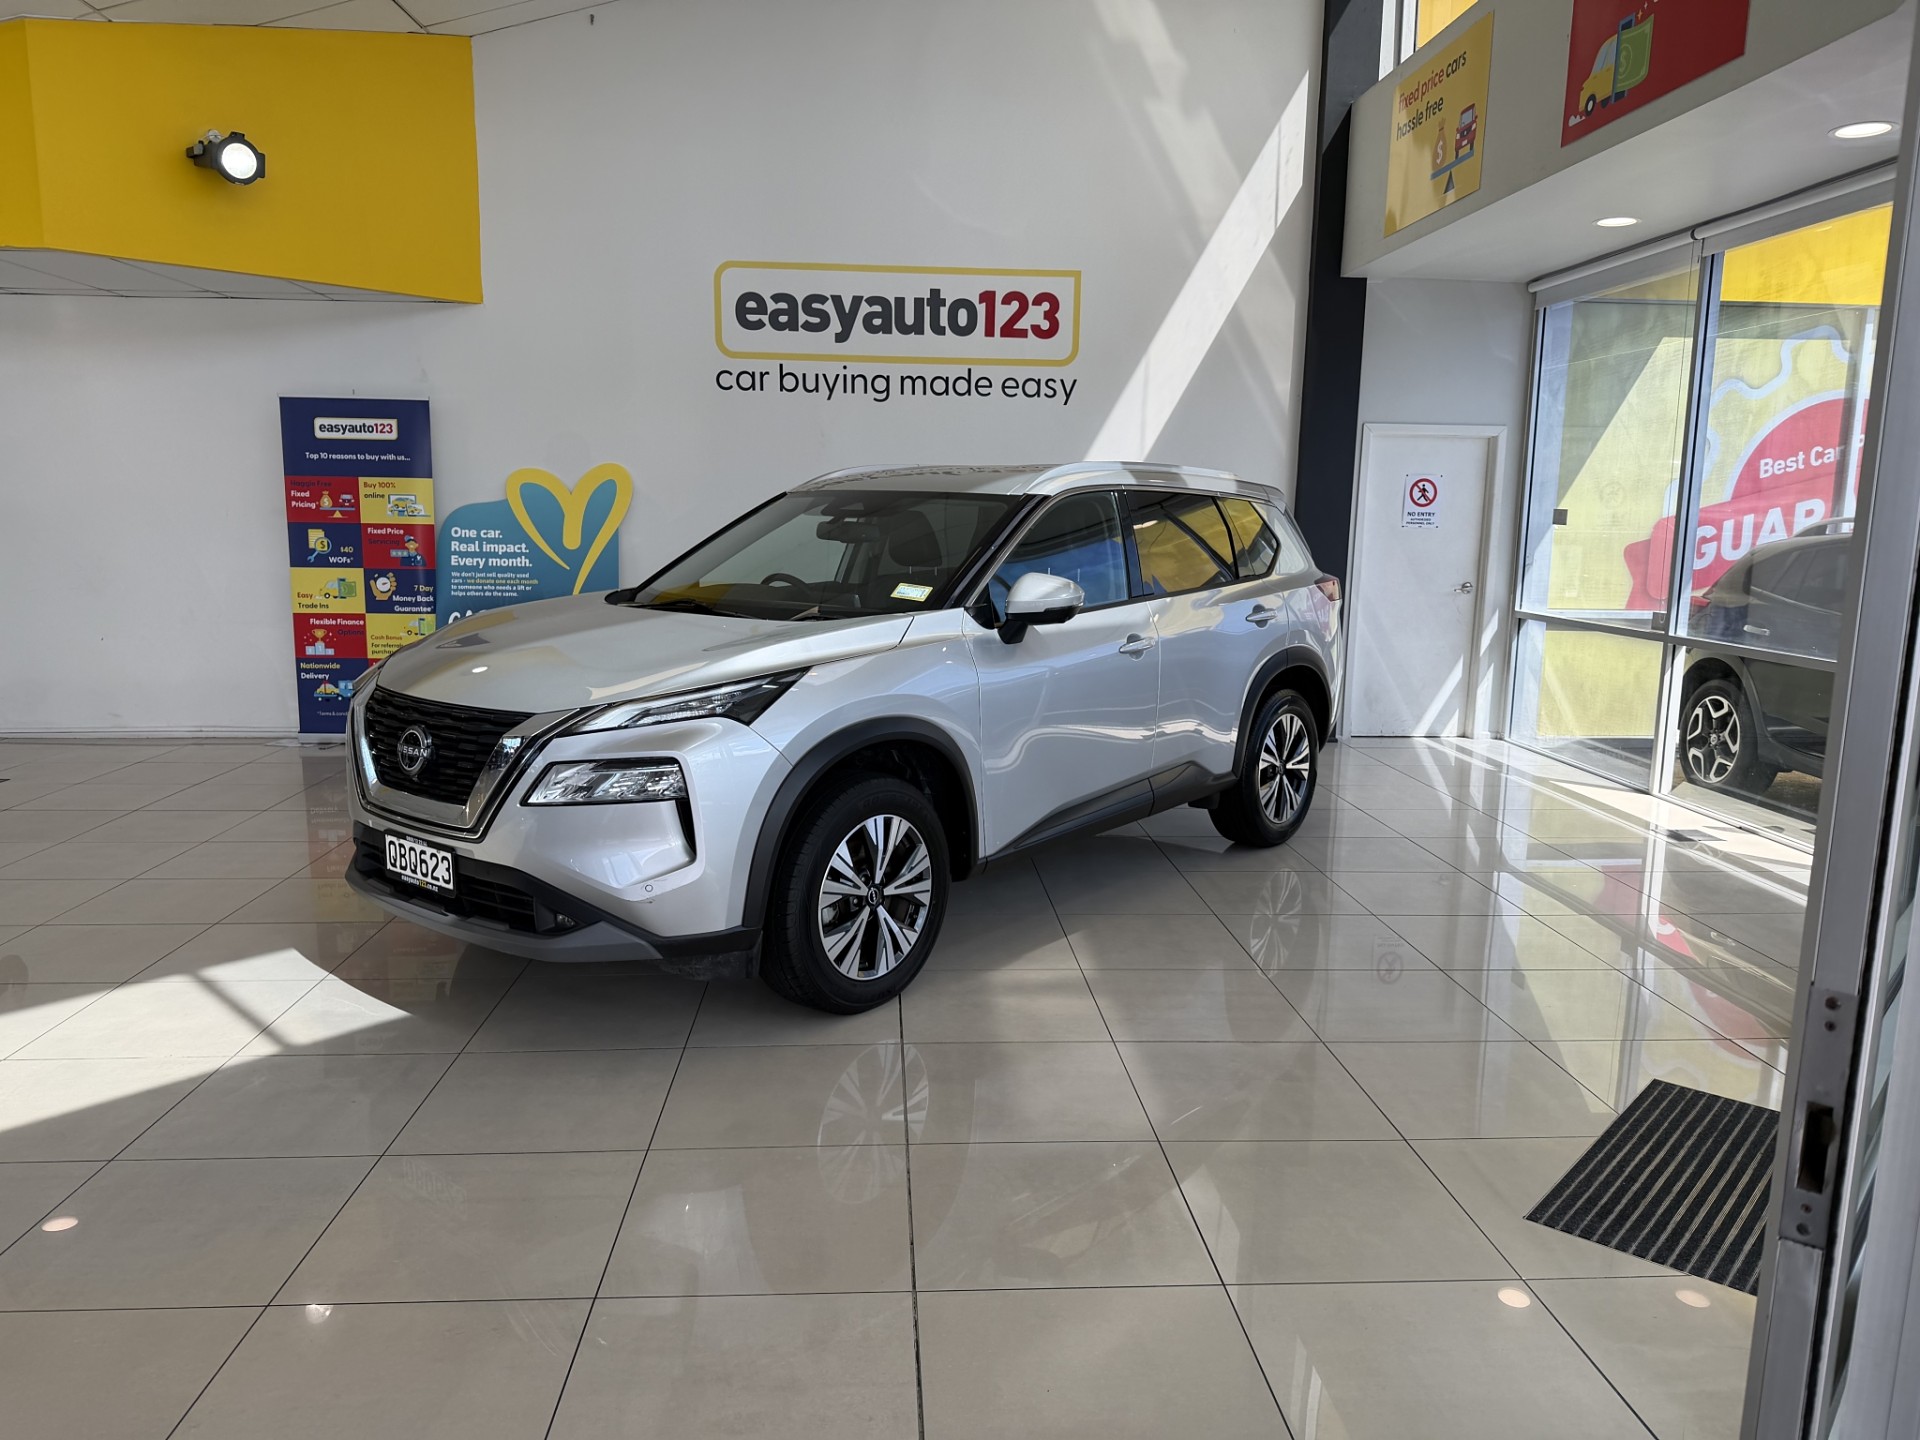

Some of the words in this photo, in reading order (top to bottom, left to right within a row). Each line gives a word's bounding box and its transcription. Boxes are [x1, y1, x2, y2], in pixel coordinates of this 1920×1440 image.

[1398, 80, 1420, 114] fixed
[1420, 69, 1445, 102] price
[1446, 51, 1467, 78] cars
[1396, 108, 1423, 141] hassle
[1425, 96, 1444, 122] free
[735, 288, 1060, 343] easyauto123
[715, 368, 769, 392] car
[779, 364, 890, 402] buying
[900, 368, 992, 396] made
[1001, 377, 1077, 405] easy
[318, 422, 393, 435] easyauto123
[305, 452, 319, 460] Top
[366, 453, 379, 462] buy
[1760, 451, 1805, 479] Best
[451, 527, 477, 537] One
[480, 529, 503, 538] car.
[451, 541, 479, 552] Real
[482, 542, 529, 555] impact.
[451, 555, 486, 568] Every
[488, 556, 532, 567] month.
[419, 585, 434, 593] Day
[297, 592, 313, 600] Easy
[393, 595, 415, 603] Money
[337, 618, 364, 626] Finance
[388, 840, 451, 885] QBQ623
